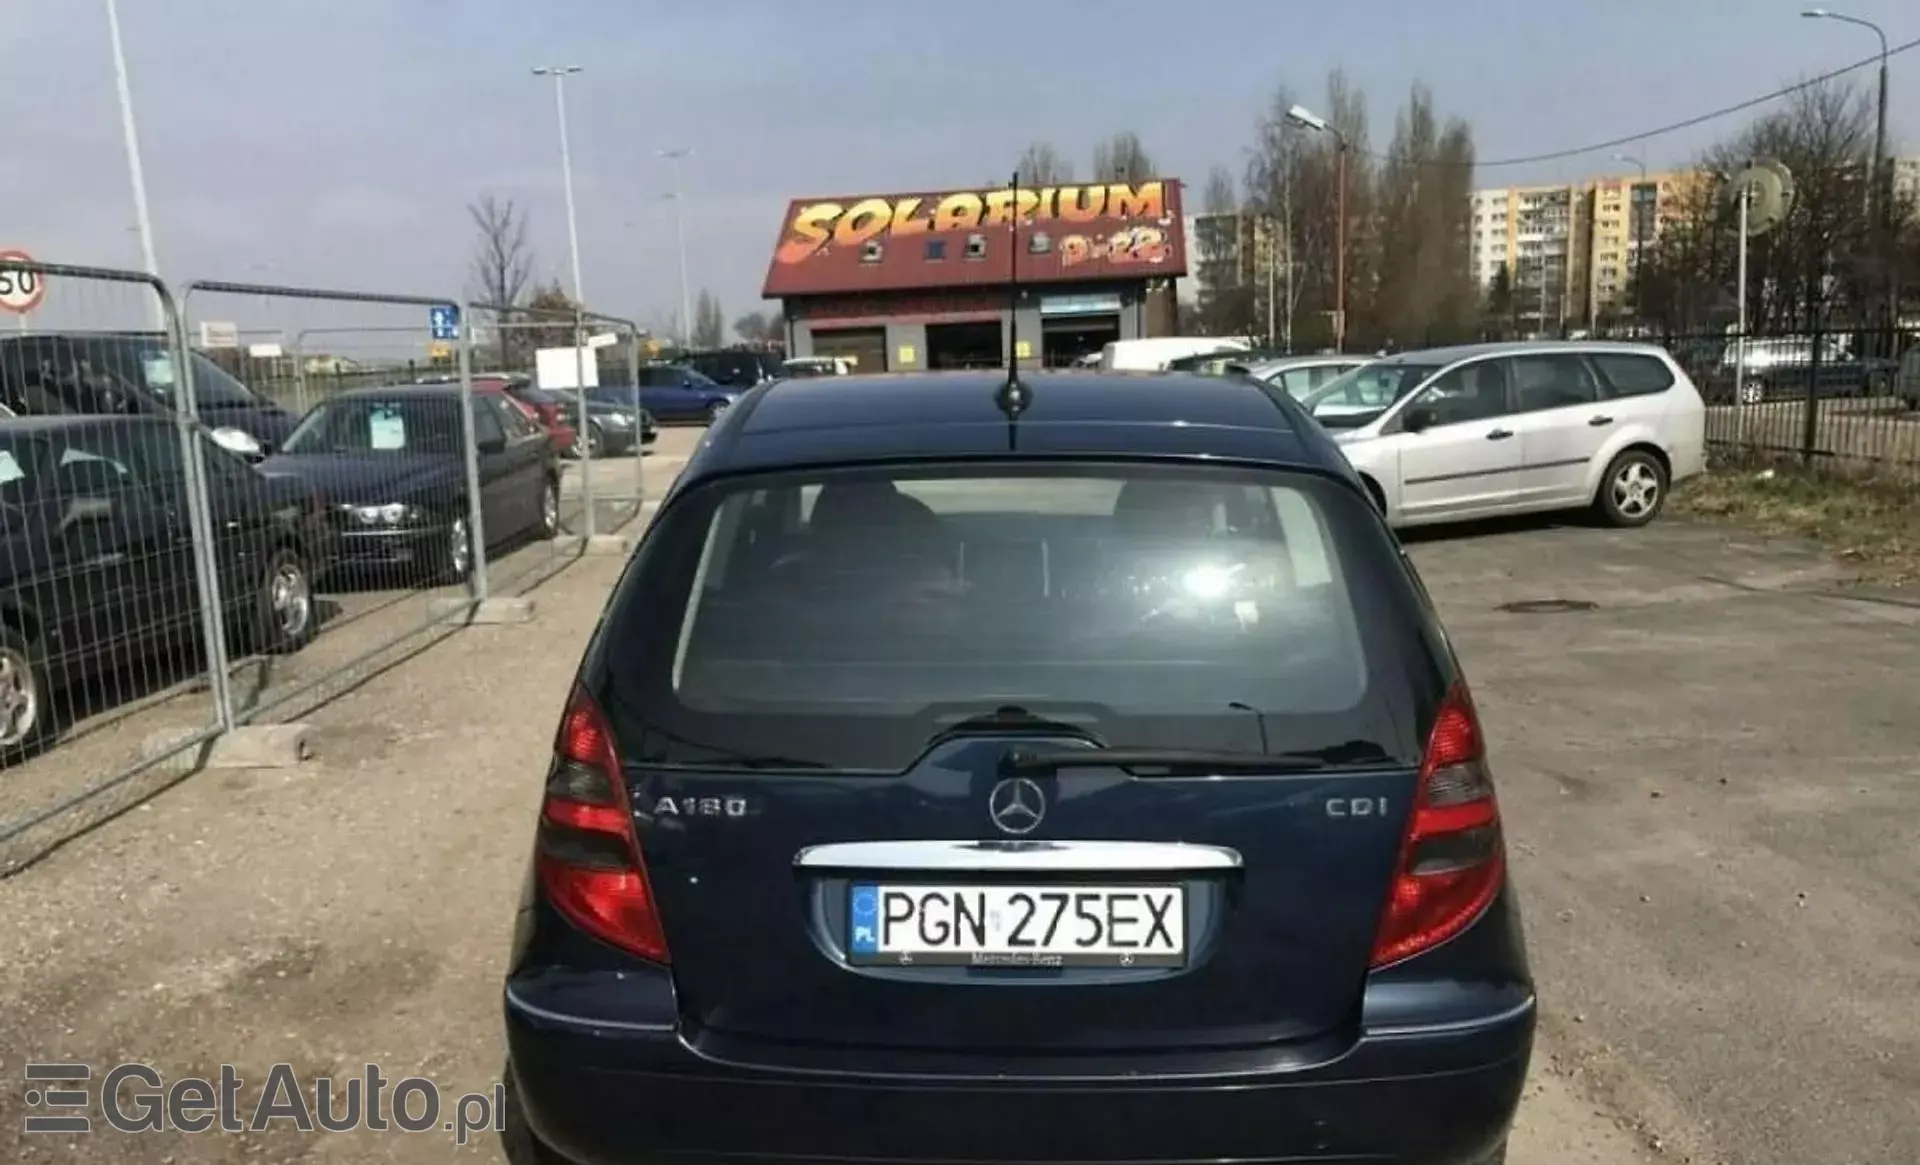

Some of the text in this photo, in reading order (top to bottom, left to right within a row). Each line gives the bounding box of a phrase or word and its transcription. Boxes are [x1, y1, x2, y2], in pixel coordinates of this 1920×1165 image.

[777, 181, 1164, 264] SOLARIUM
[1326, 797, 1387, 816] CDI
[884, 892, 1174, 948] PGN 275EX
